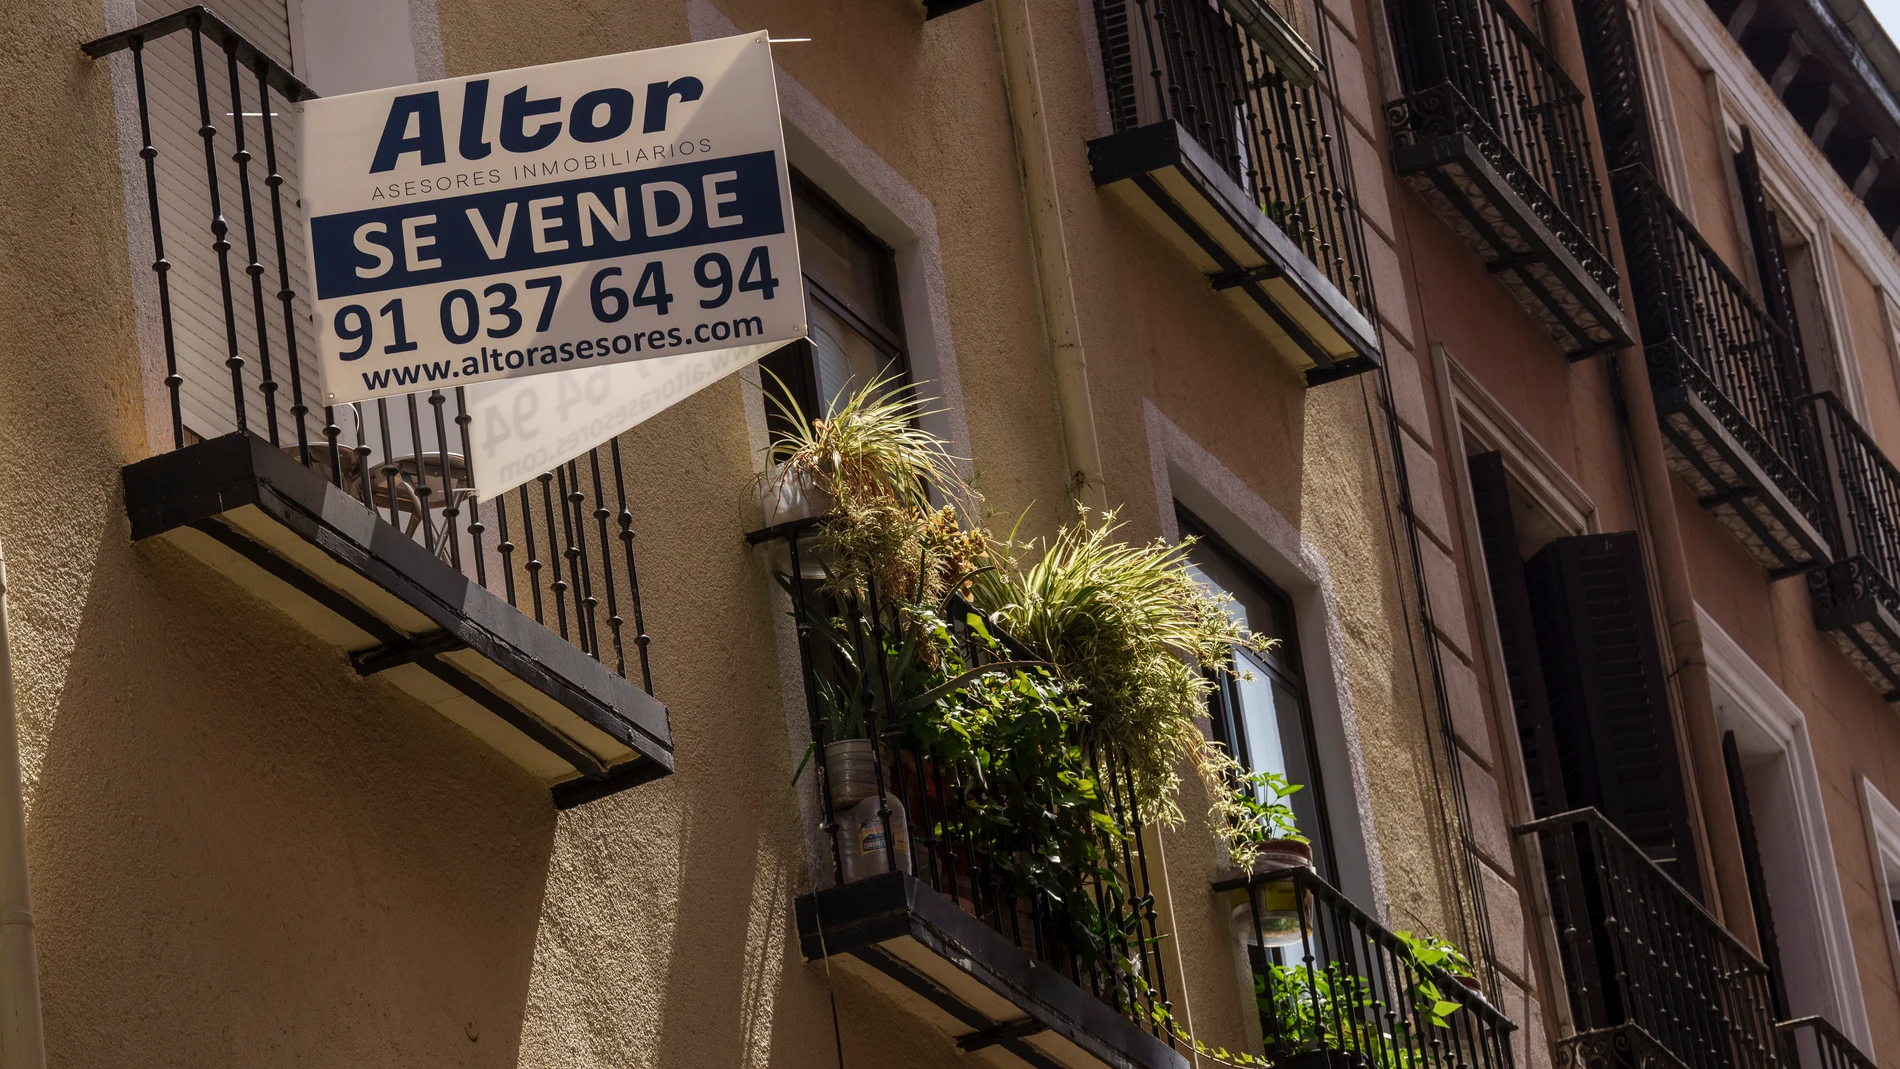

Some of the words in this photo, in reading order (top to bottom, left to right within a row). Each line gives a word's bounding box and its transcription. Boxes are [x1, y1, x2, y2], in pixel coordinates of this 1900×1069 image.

[368, 76, 704, 175] Altor
[371, 169, 501, 201] ASESORES
[513, 138, 713, 180] INMOBILIARIOS
[353, 213, 442, 279] SE
[465, 170, 743, 260] VENDE
[333, 298, 418, 361] 91
[439, 275, 563, 345] 037
[590, 260, 673, 323] 64
[694, 246, 780, 309] 94
[361, 315, 764, 391] www.altorasesores.com
